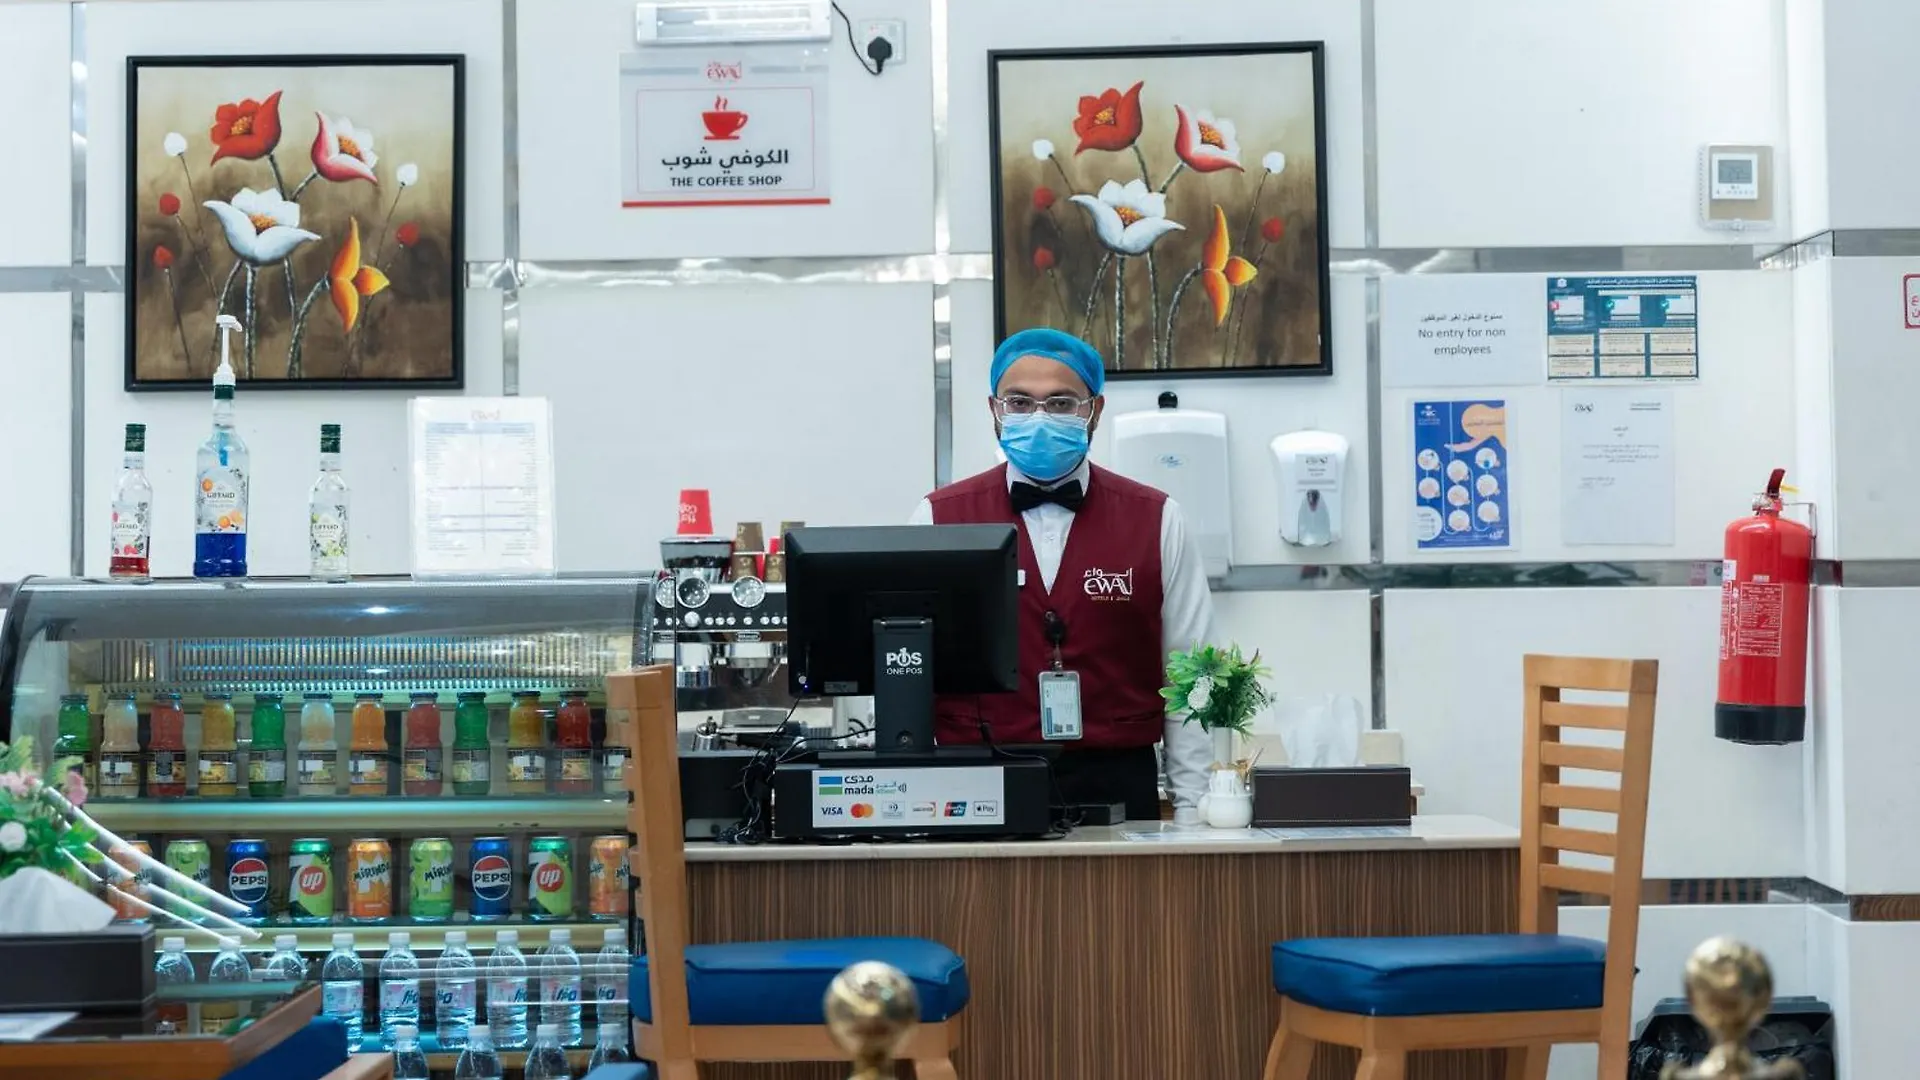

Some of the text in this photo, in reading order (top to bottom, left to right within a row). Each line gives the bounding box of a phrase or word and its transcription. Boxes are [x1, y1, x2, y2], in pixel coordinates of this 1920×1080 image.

[661, 146, 788, 174] الكوفي شوب
[670, 175, 782, 187] THE COFFEE SHOP
[1418, 327, 1506, 341] No entry for non
[1434, 343, 1491, 357] employees
[886, 647, 922, 667] POS
[886, 667, 922, 675] ONE POS
[844, 785, 874, 795] mada
[821, 806, 843, 816] VISA
[982, 805, 995, 814] Pay
[231, 875, 267, 885] PEPSI
[474, 873, 510, 883] PEPSI
